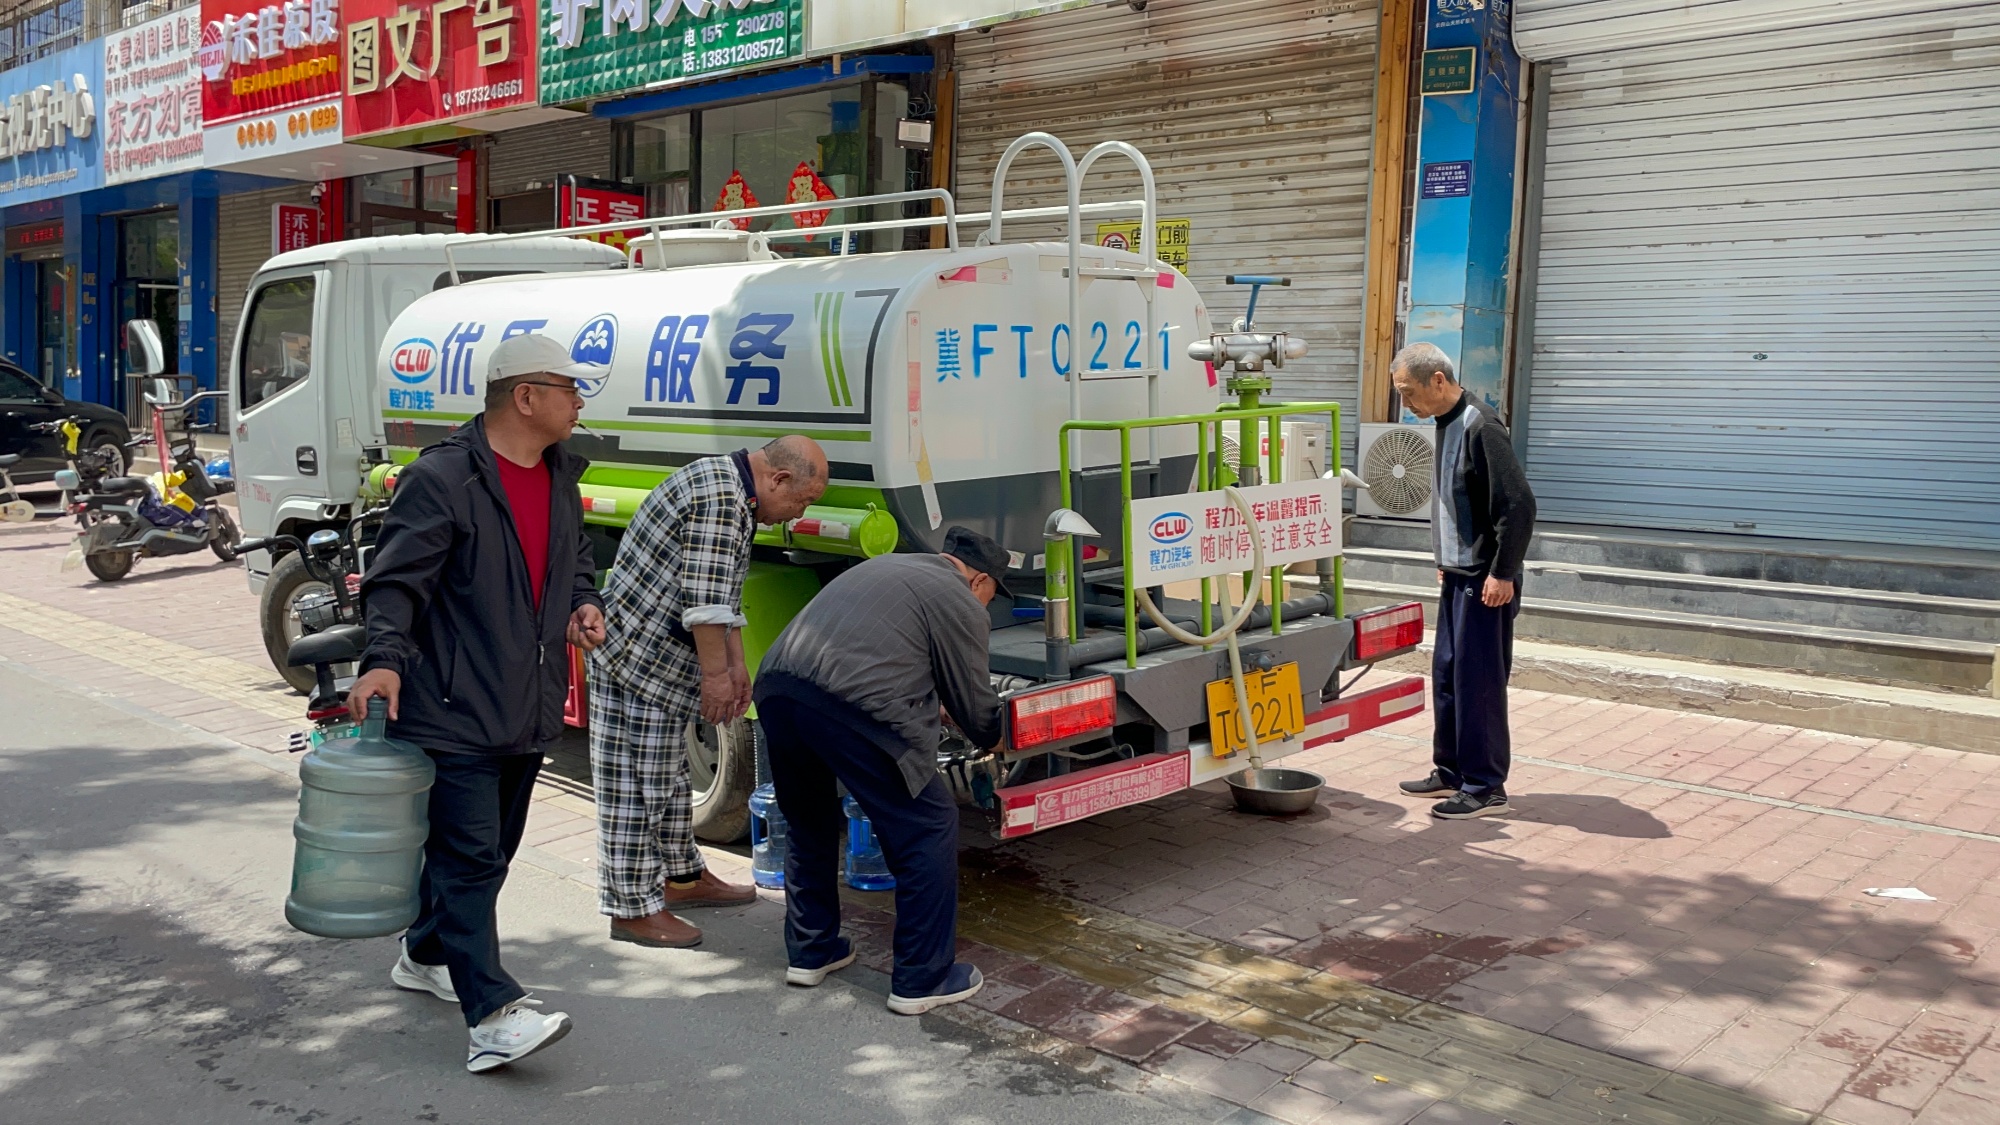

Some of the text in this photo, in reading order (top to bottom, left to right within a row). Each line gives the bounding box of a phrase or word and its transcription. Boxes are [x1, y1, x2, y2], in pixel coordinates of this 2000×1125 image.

[684, 26, 696, 48] 电
[736, 10, 784, 37] 290278
[348, 0, 514, 96] 图文广告
[455, 79, 523, 107] 18733246661
[106, 77, 203, 147] 东方刻章
[310, 105, 338, 132] 1999
[568, 196, 639, 223] 正宗
[395, 348, 432, 373] CLW
[644, 311, 795, 405] 服务
[389, 387, 436, 411] 程力汽车
[1154, 518, 1187, 538] CLW
[1271, 517, 1332, 553] 注意安全
[1150, 545, 1192, 565] 程力汽车
[1089, 786, 1150, 812] 15826785399
